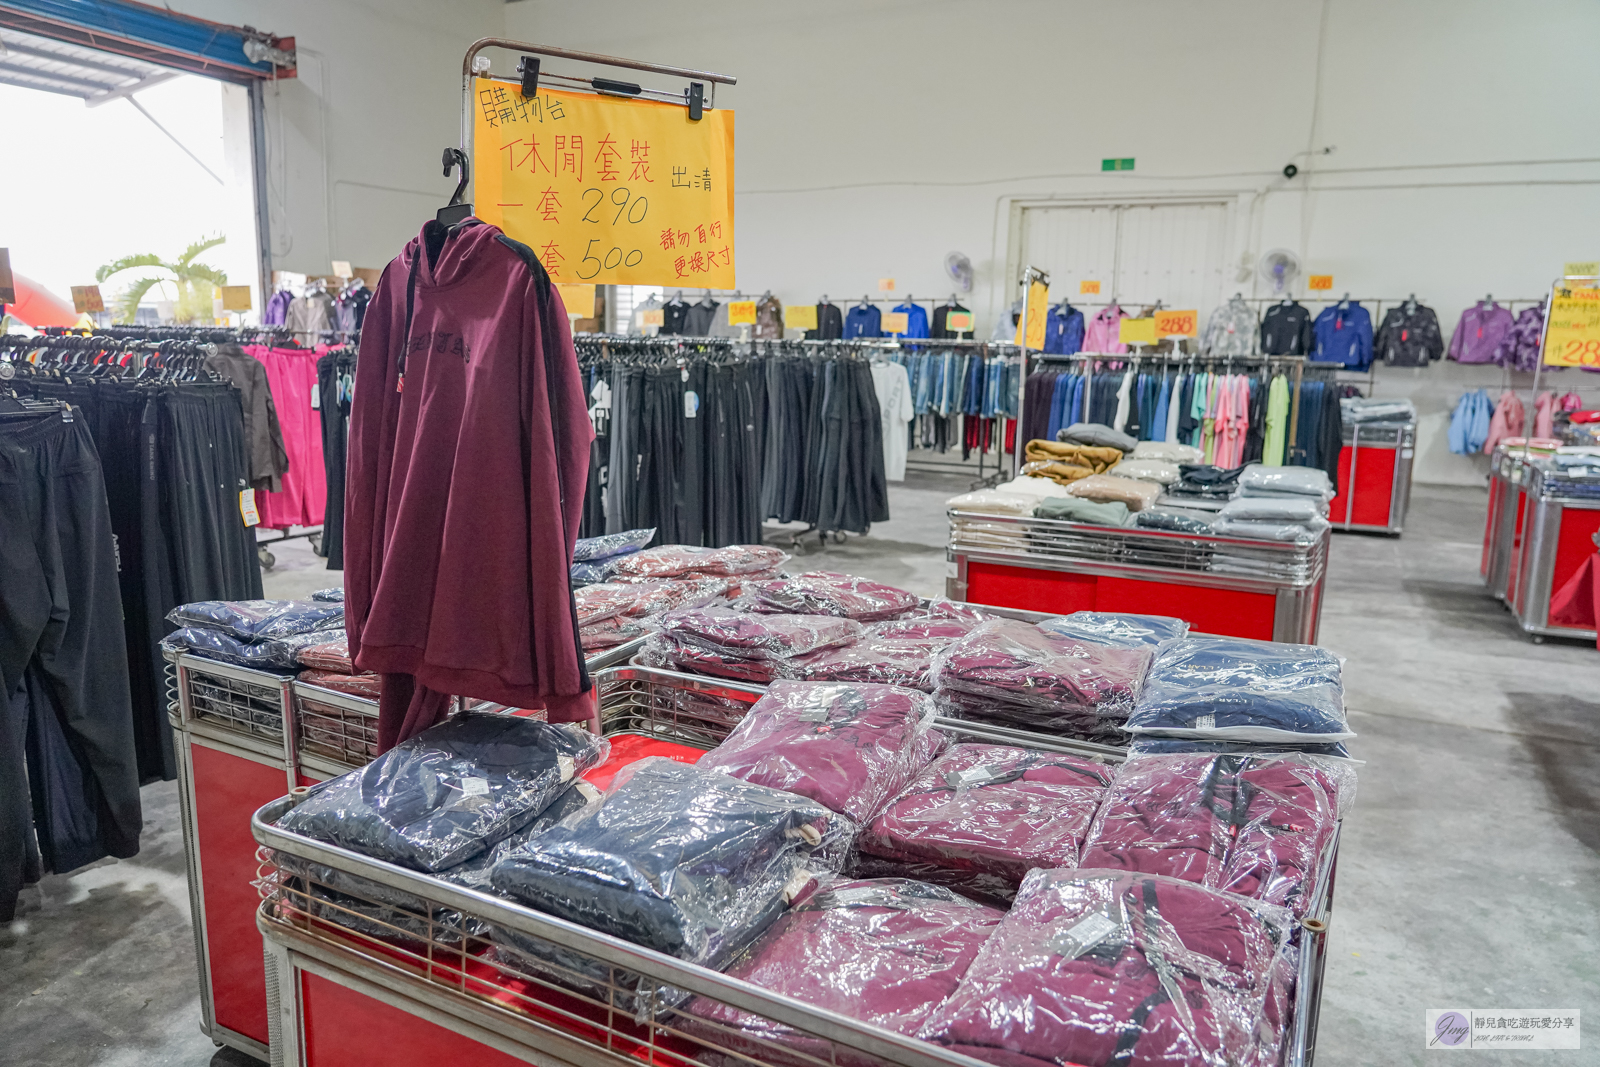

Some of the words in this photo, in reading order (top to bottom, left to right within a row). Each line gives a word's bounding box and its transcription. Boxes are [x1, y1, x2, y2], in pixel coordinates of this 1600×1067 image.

[479, 87, 566, 128] 購物台
[499, 132, 655, 183] 休閒套裝
[671, 165, 712, 192] 出清
[497, 186, 563, 224] 一套
[581, 187, 648, 226] 290
[575, 239, 643, 280] 500
[673, 245, 731, 280] 更換尺寸
[1160, 316, 1193, 335] 288
